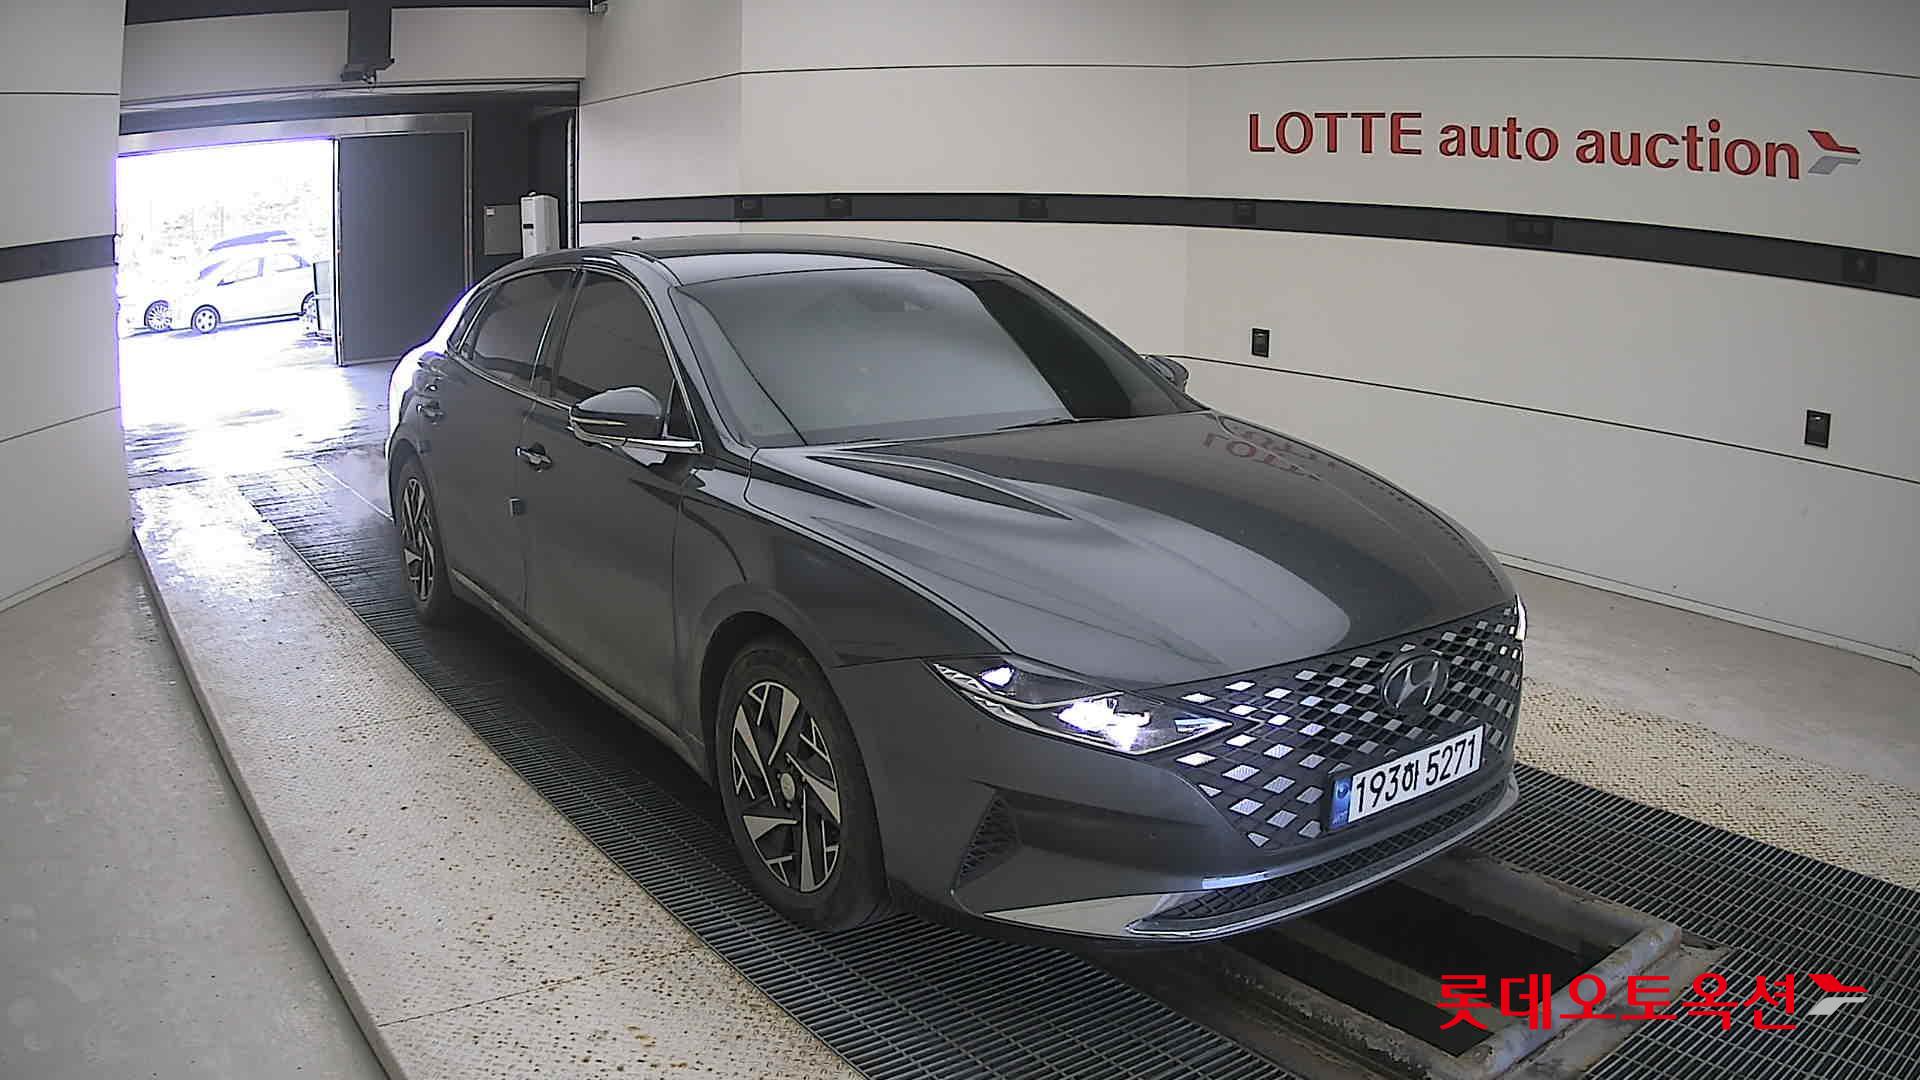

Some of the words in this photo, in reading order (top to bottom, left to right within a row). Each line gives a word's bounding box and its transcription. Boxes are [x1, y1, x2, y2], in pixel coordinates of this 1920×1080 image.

[1249, 111, 1422, 155] LOTTE
[1439, 116, 1560, 162] auto
[1575, 119, 1800, 179] auction
[1356, 759, 1420, 813] 193하
[1425, 734, 1477, 786] 5271
